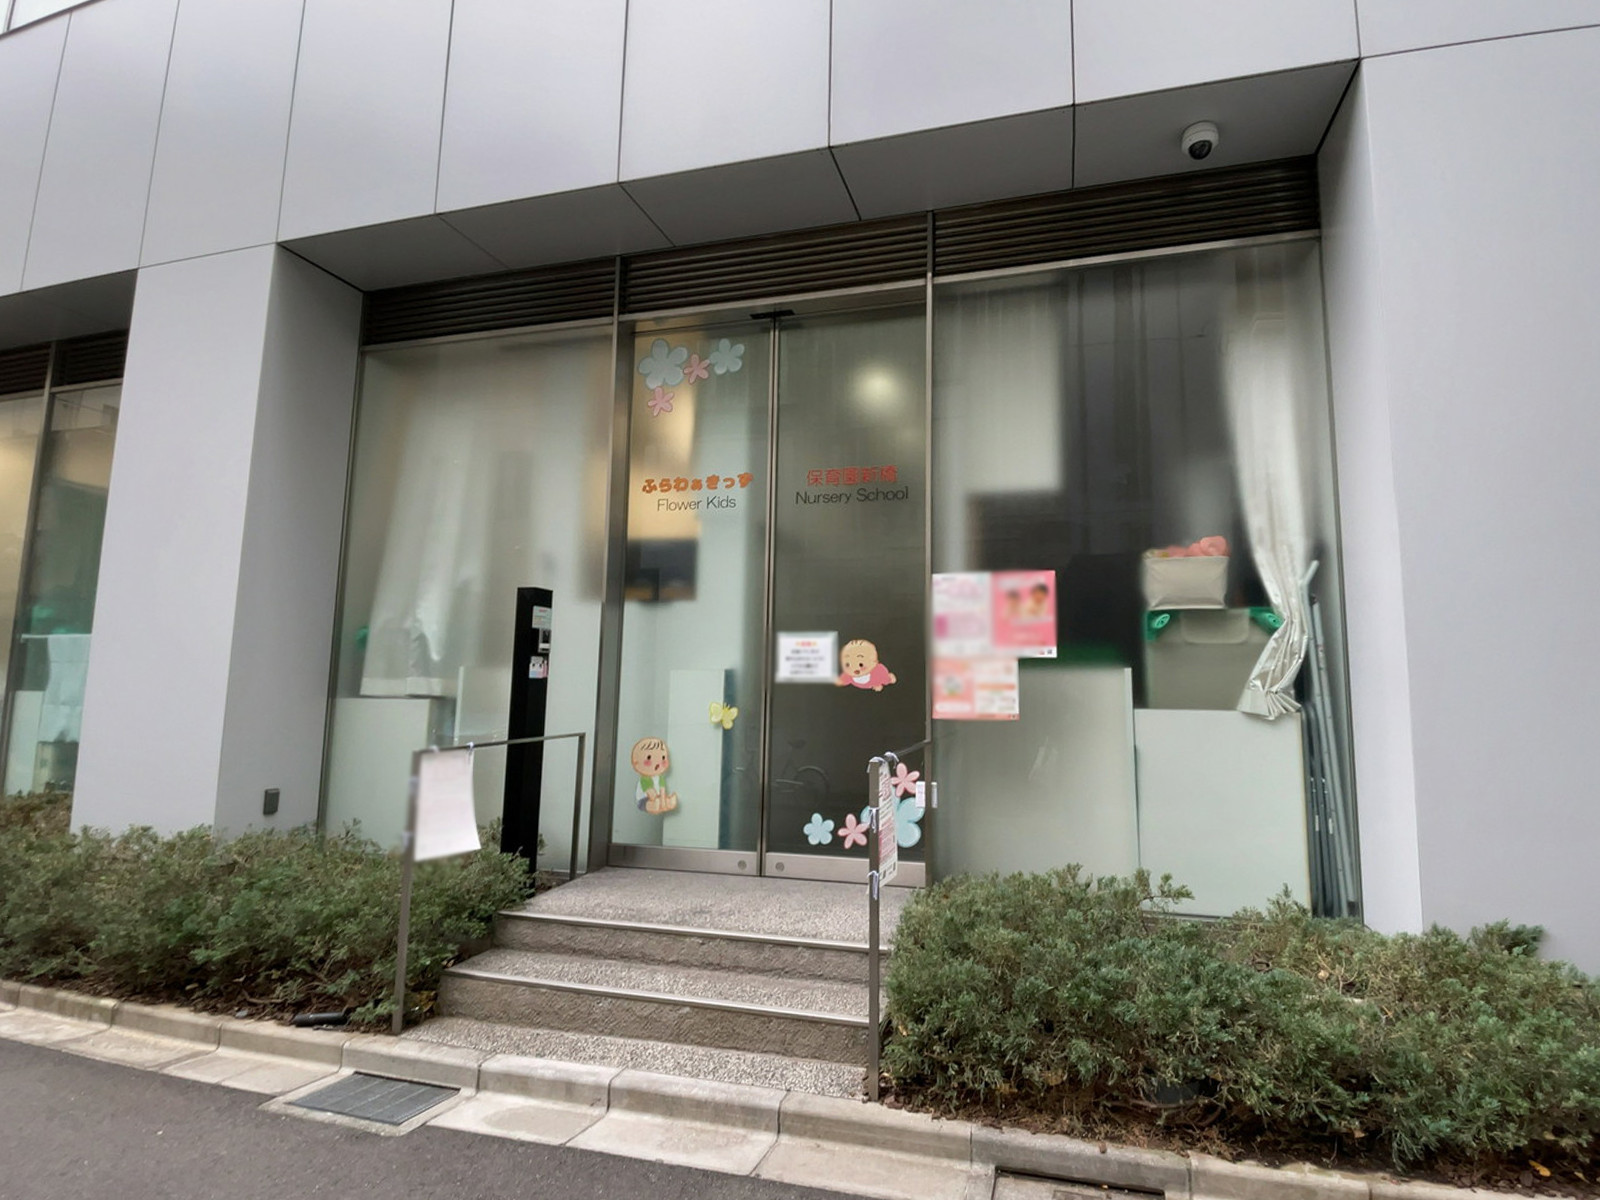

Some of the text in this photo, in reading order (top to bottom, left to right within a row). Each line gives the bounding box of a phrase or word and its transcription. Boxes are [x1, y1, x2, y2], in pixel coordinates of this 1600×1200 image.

[657, 495, 737, 511] Flower Kids
[795, 485, 909, 504] Nursery School
